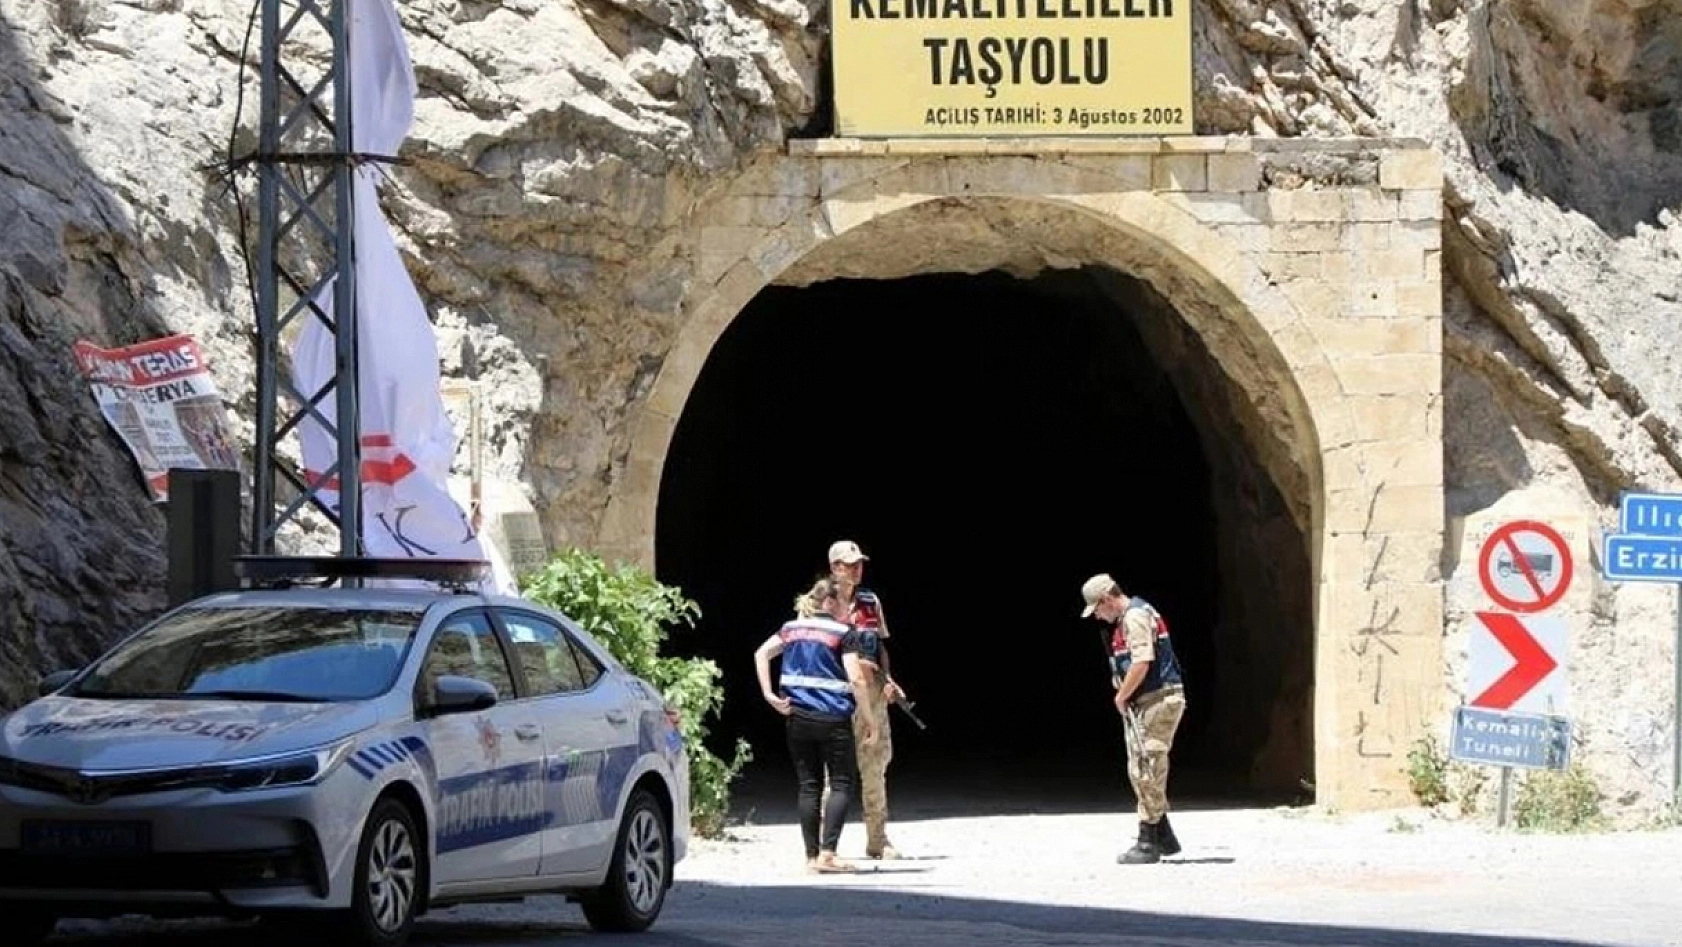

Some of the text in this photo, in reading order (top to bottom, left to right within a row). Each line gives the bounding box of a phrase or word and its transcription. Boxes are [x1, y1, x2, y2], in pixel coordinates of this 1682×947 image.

[923, 36, 1109, 98] TAŞYOLU
[1053, 108, 1063, 124] 3
[1068, 108, 1138, 129] Ağustos
[1142, 108, 1183, 124] 2002
[1617, 545, 1682, 570] Erzi
